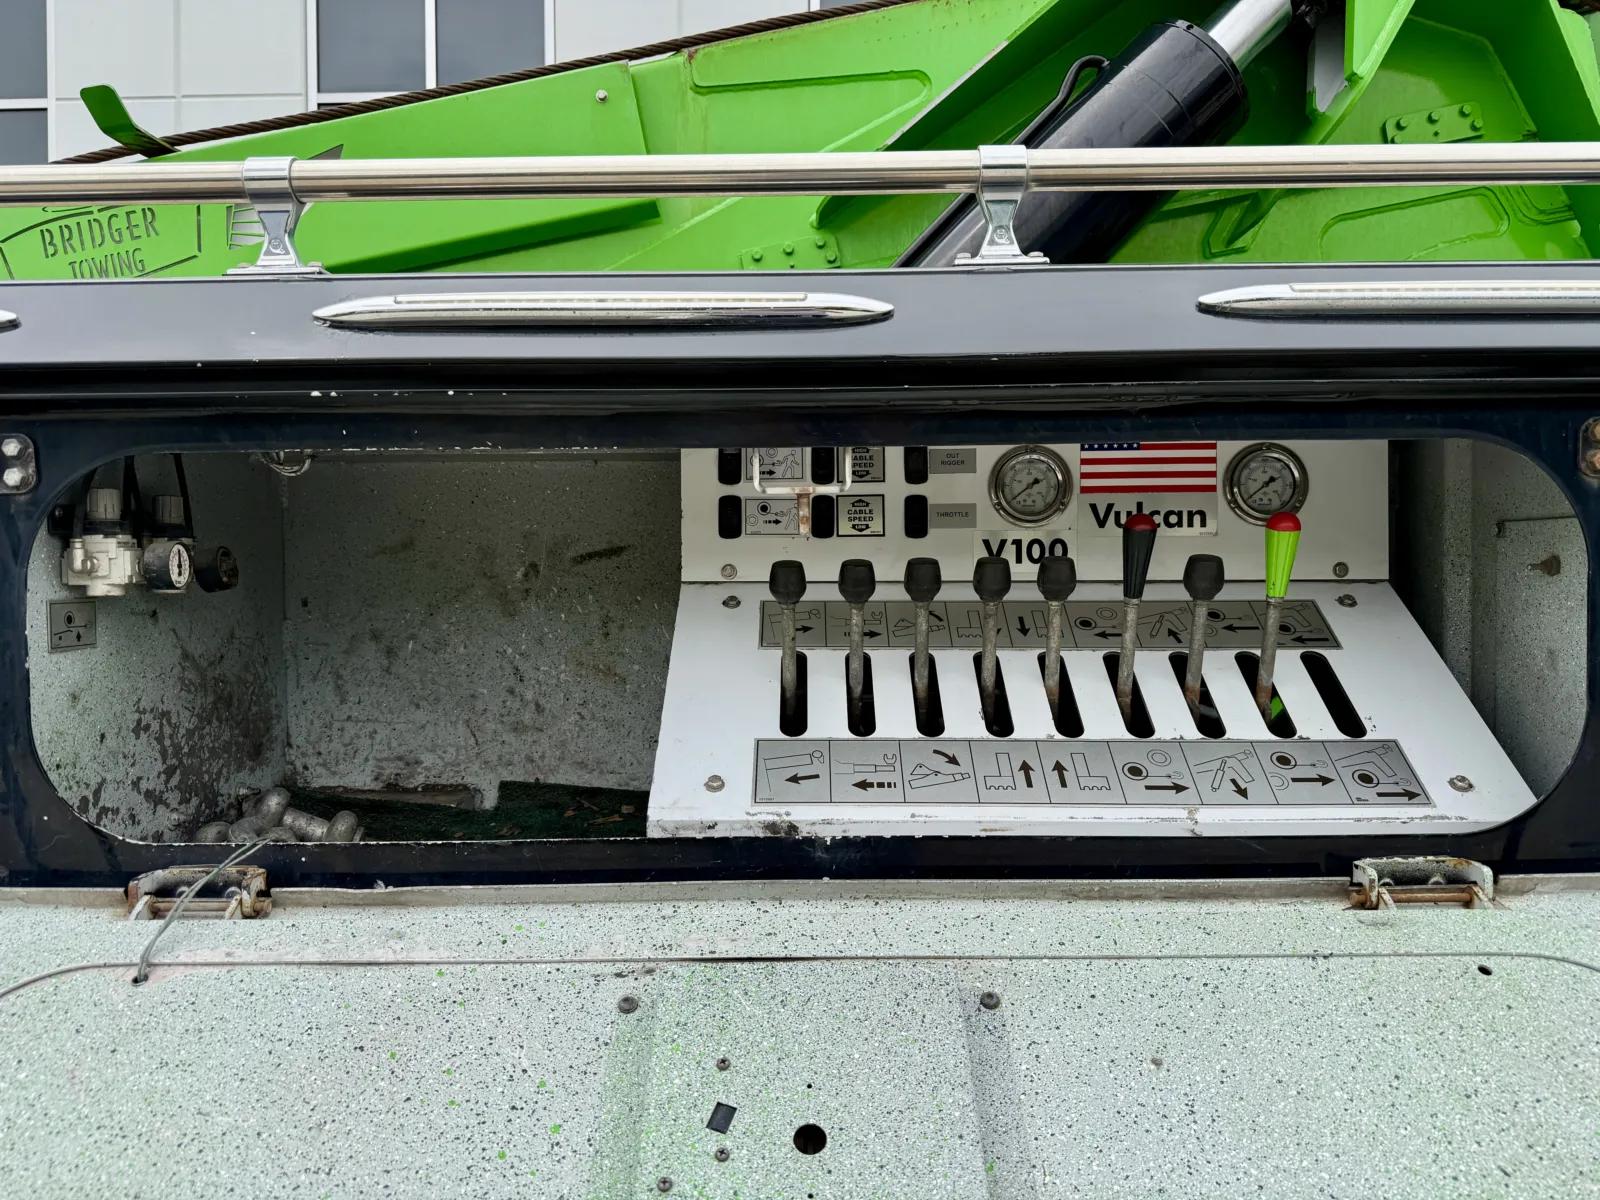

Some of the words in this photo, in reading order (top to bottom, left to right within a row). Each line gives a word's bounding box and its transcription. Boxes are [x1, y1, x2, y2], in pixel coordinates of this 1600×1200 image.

[40, 207, 160, 259] BRIDGER
[68, 248, 146, 280] TOWING
[981, 538, 1069, 564] V100
